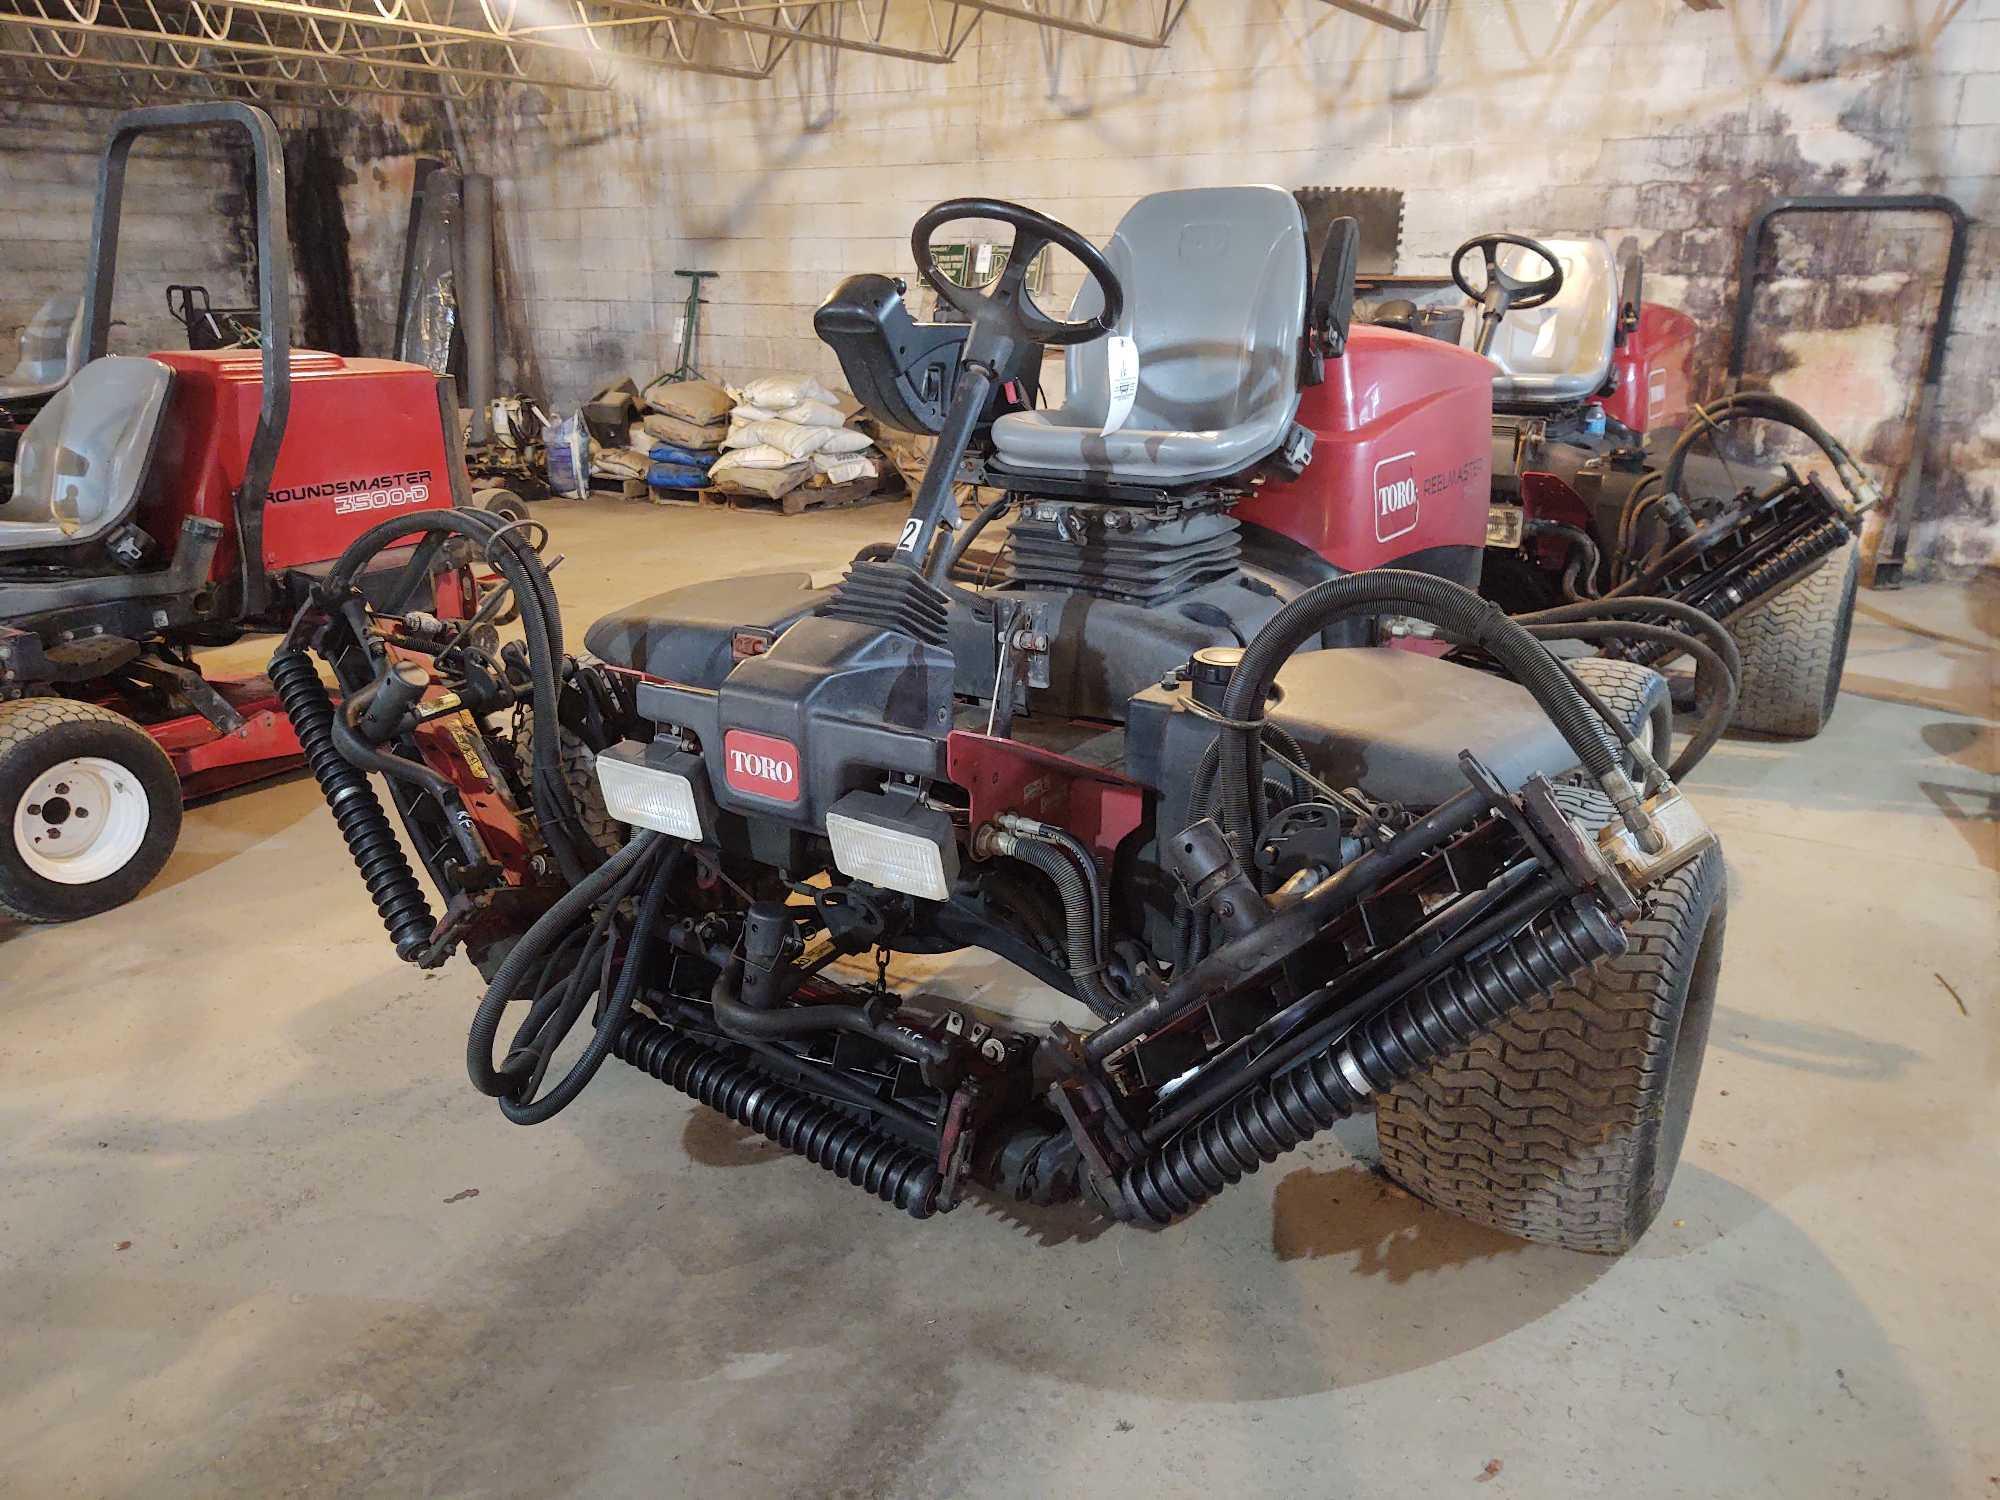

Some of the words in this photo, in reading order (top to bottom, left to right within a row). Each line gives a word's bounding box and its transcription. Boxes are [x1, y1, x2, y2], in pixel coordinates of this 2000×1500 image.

[334, 484, 429, 514] 3500-D
[1379, 478, 1415, 515] TORO
[900, 521, 917, 548] 2
[730, 749, 793, 784] TORO
